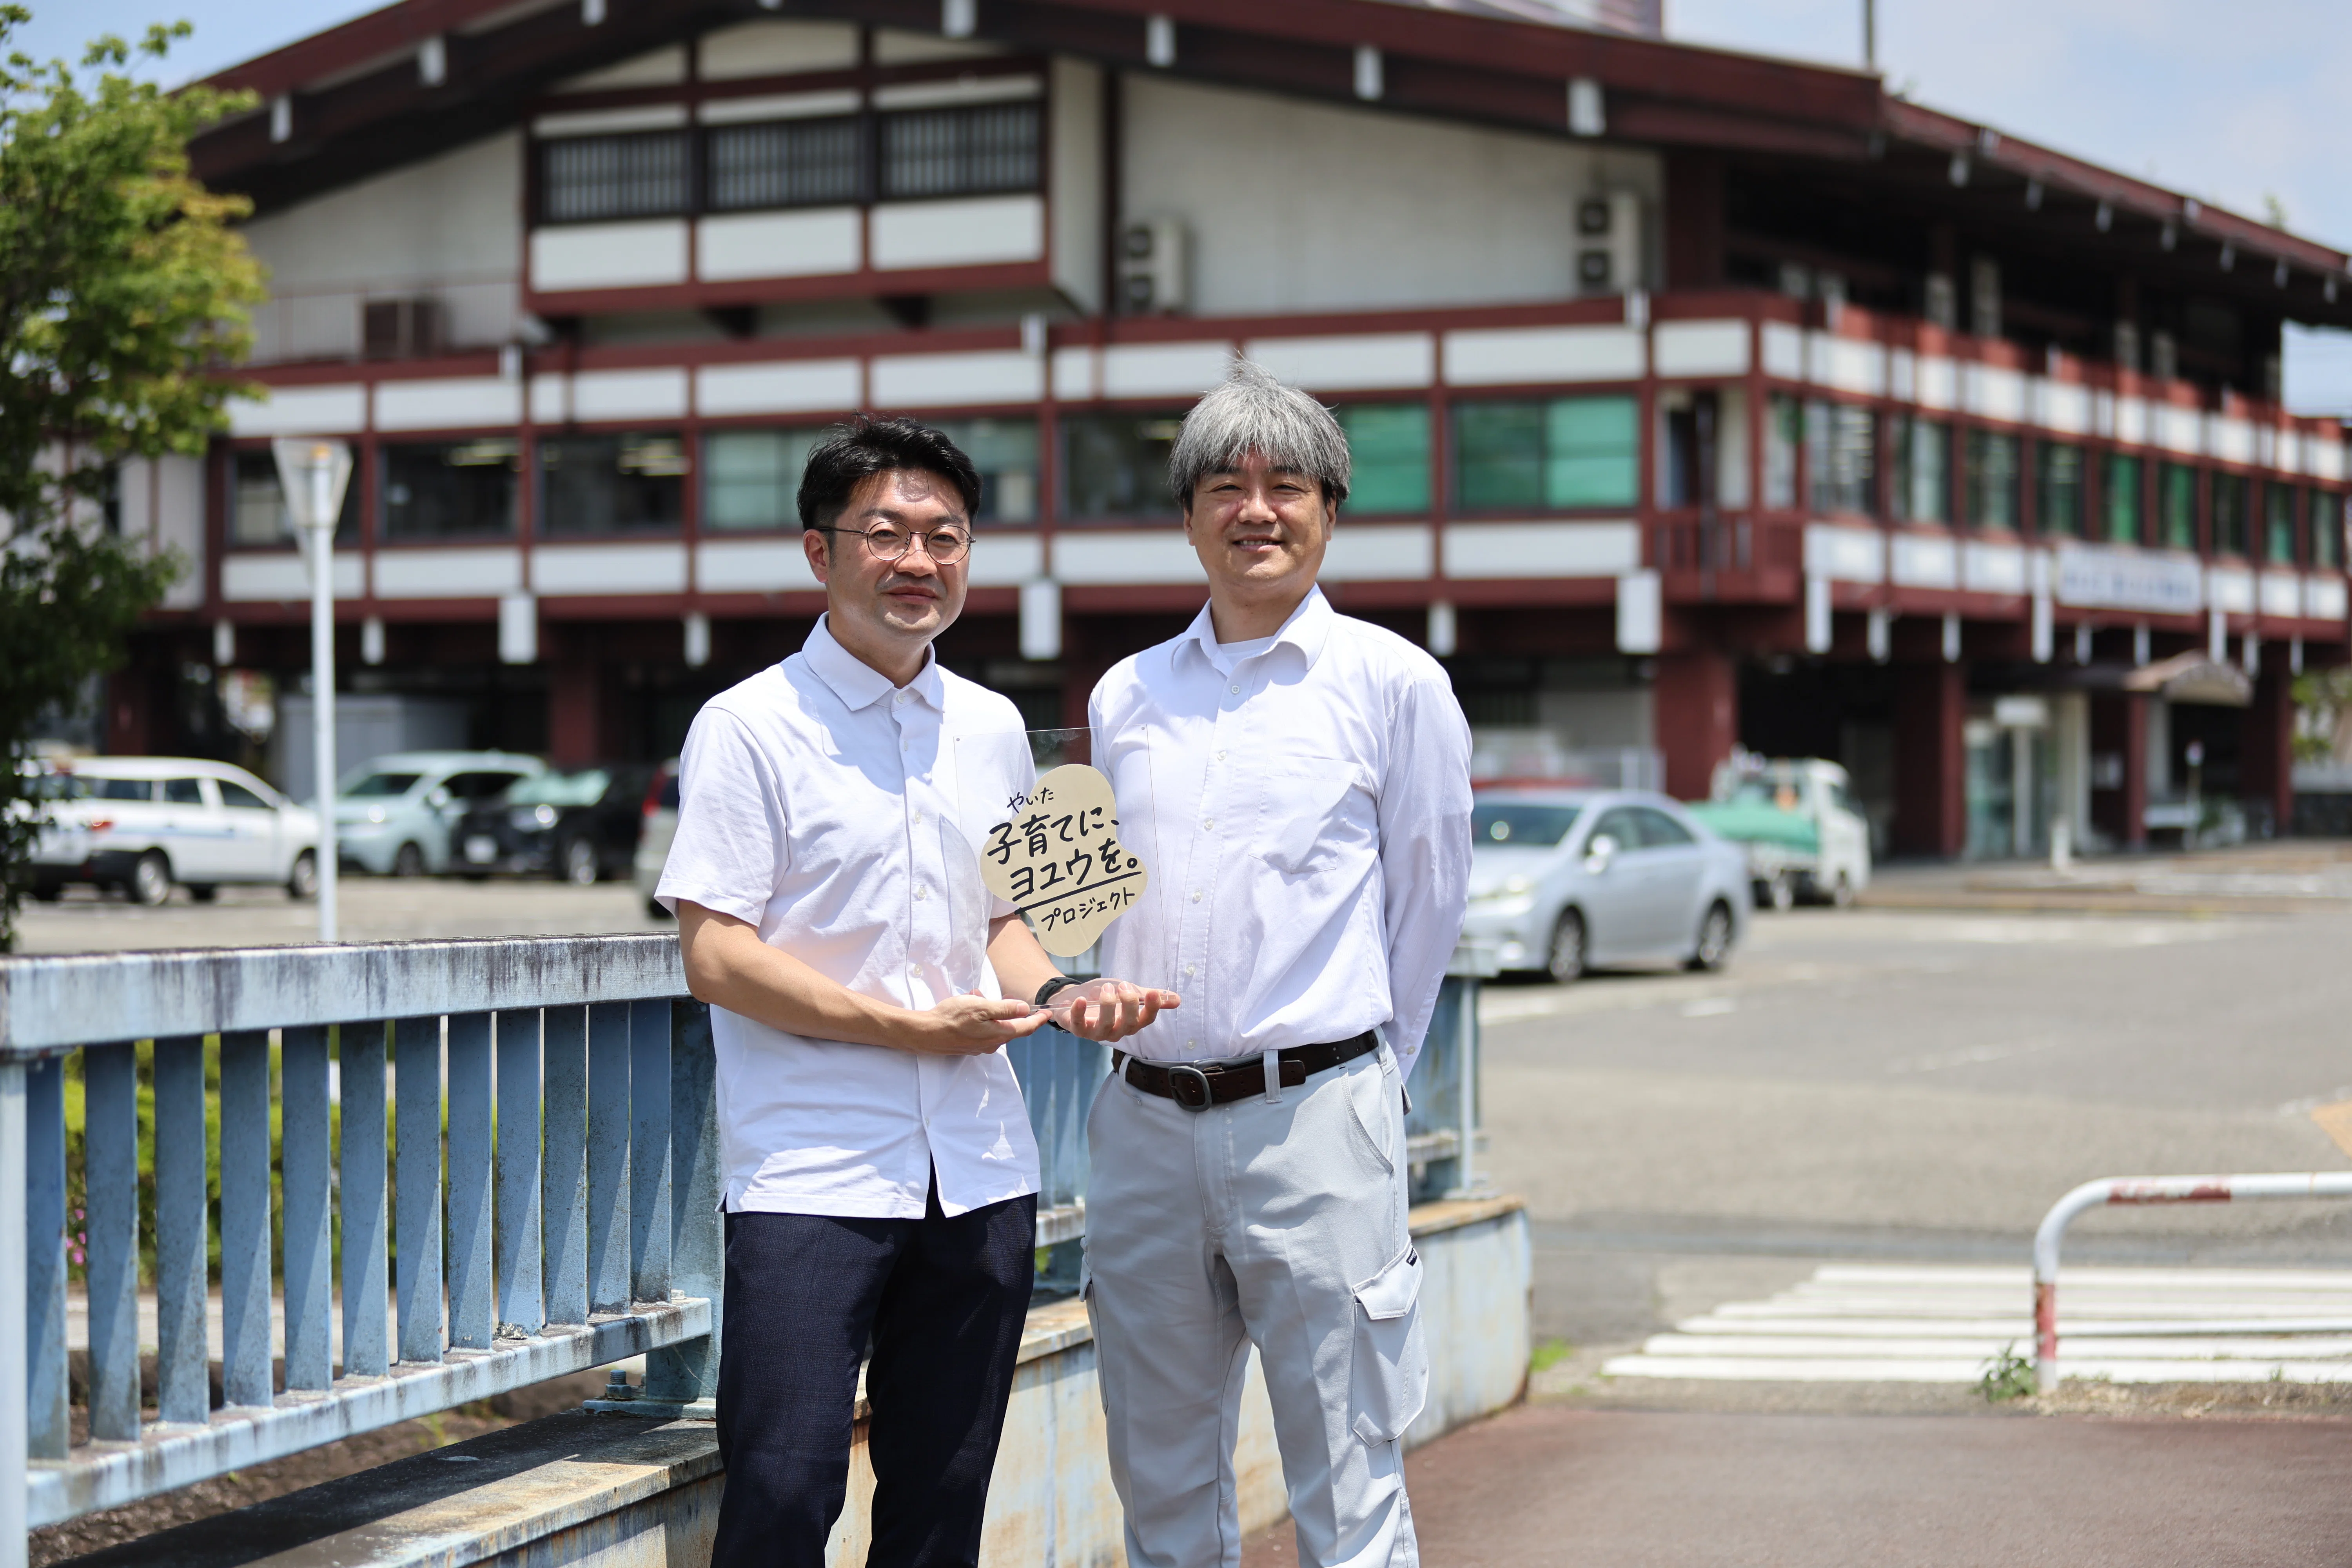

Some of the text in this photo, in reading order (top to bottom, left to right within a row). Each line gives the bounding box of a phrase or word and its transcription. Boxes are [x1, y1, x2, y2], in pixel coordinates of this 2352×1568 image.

[1007, 787, 1054, 813] やいた
[987, 806, 1120, 864] 子育てに、
[1010, 838, 1138, 902] ヨユウを。
[1041, 887, 1135, 931] プロジェクト
